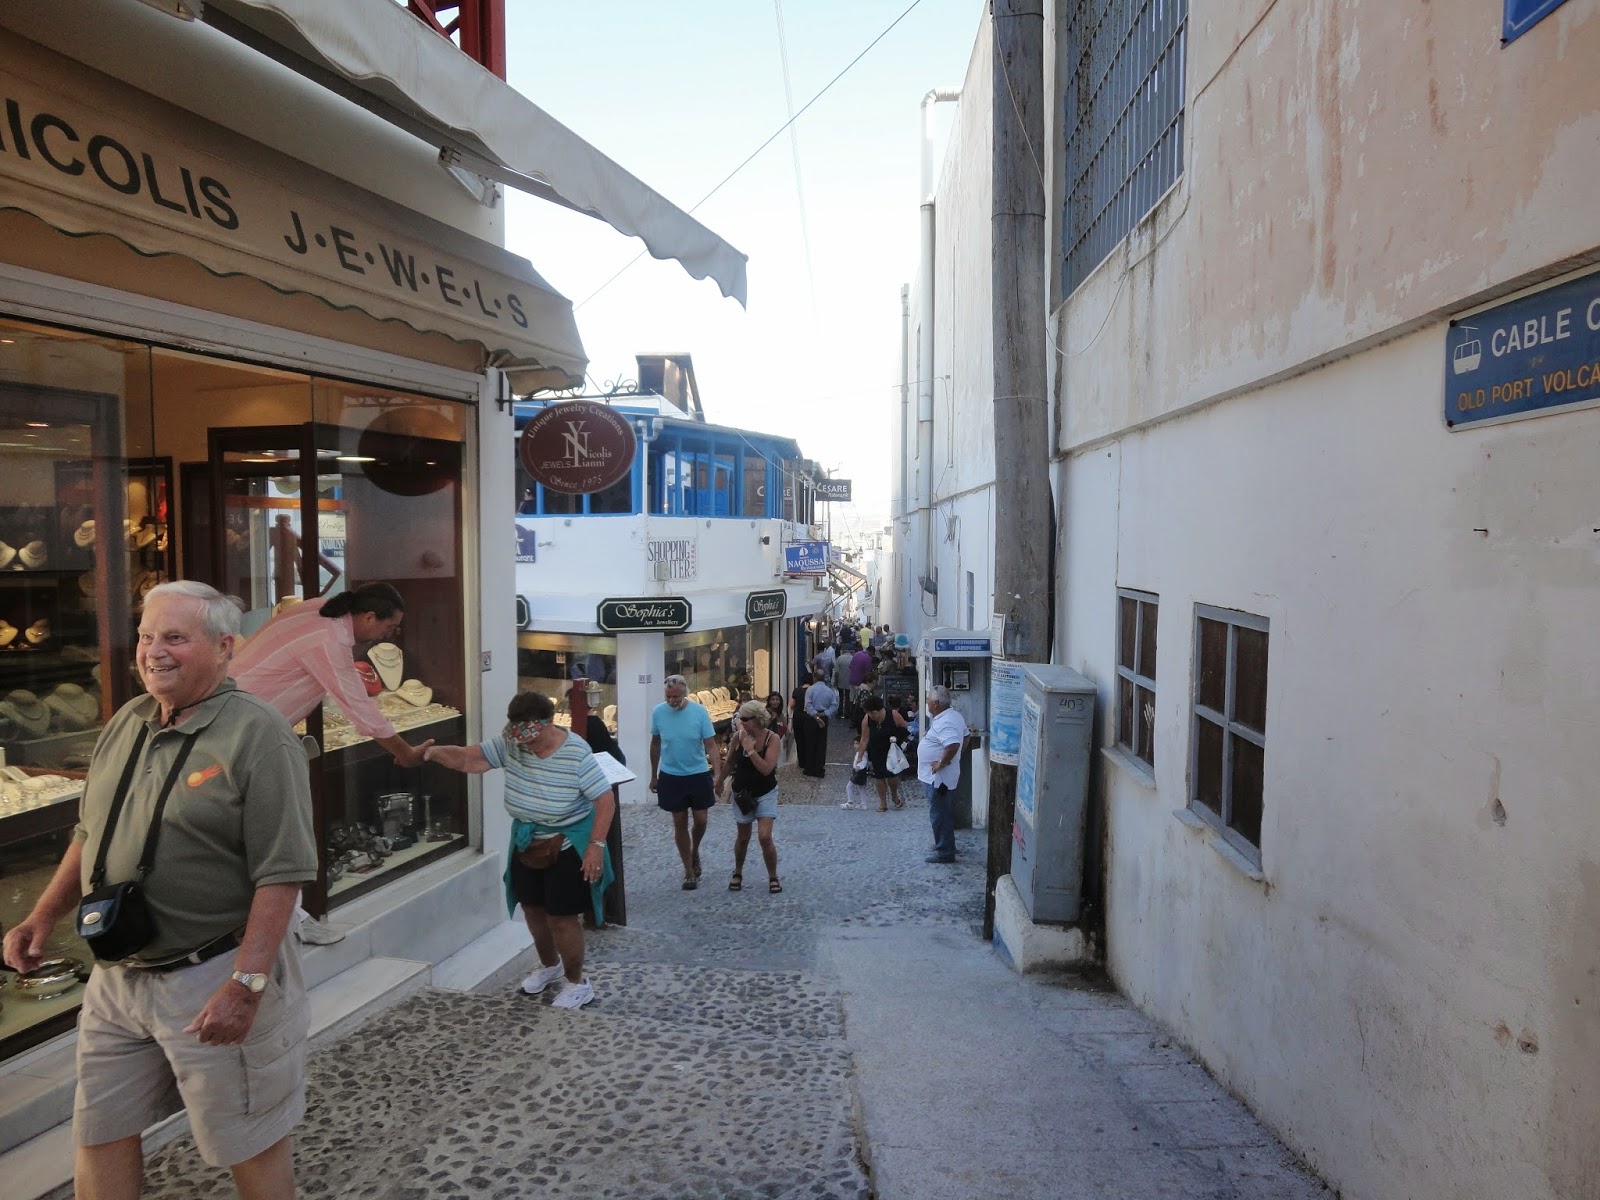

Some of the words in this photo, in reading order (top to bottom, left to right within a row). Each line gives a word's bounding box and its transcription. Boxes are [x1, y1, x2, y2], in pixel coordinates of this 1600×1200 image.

[0, 98, 240, 231] ICOLIS
[1491, 307, 1572, 357] CABLE
[1457, 389, 1486, 412] OLD
[1492, 378, 1534, 404] PORT
[527, 411, 554, 439] Unique
[553, 403, 587, 417] Jewelry
[589, 404, 624, 436] Creations
[540, 460, 572, 469] JEWELS
[549, 474, 578, 489] Since
[816, 482, 848, 494] CESARE
[647, 540, 690, 562] SHOPPING
[615, 604, 675, 622] Sophia's
